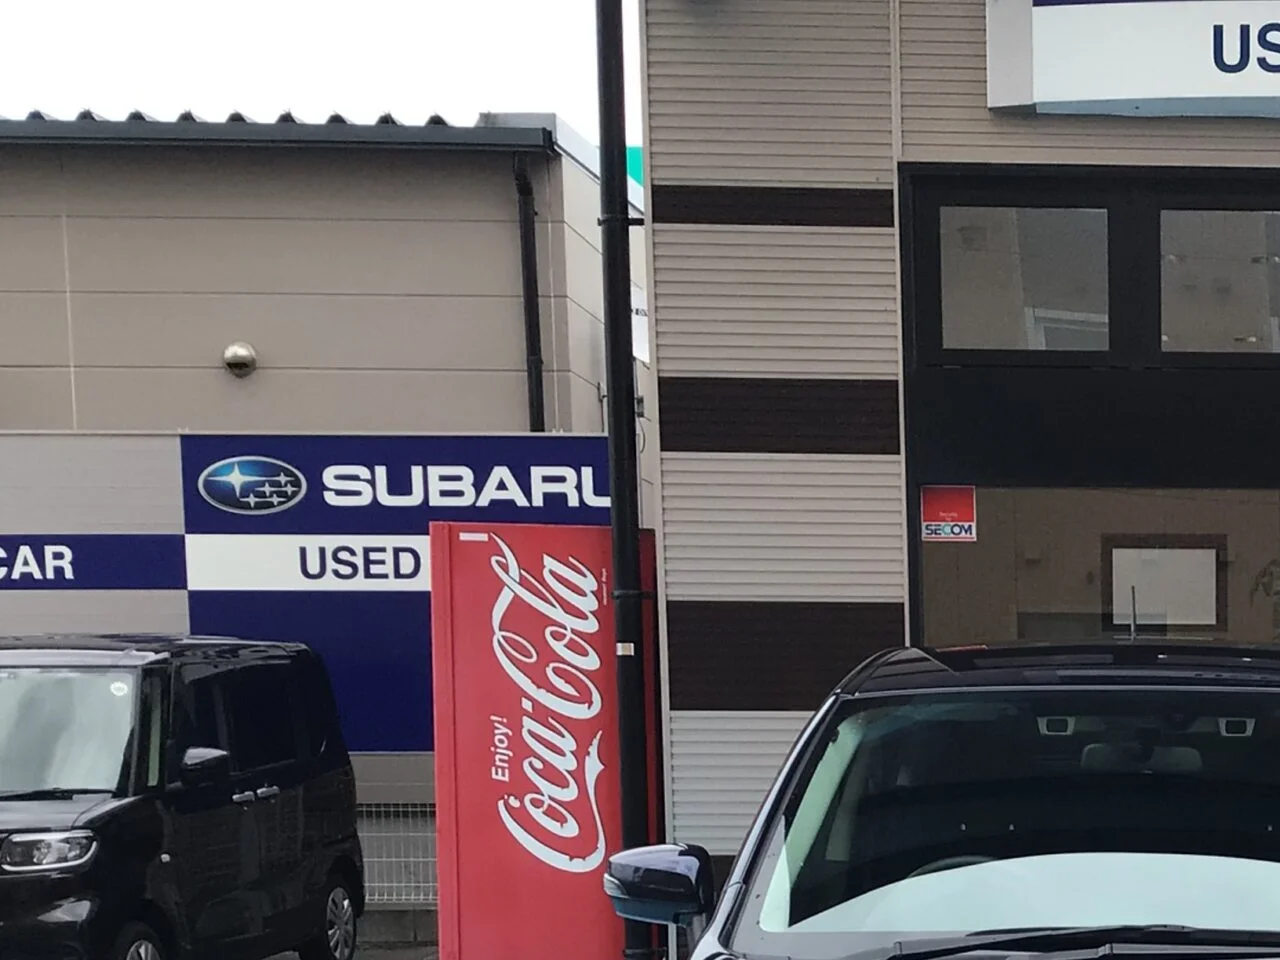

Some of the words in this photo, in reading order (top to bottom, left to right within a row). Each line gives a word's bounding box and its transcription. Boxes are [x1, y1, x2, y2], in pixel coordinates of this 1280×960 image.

[924, 523, 973, 536] SECOM
[0, 544, 75, 580] AR
[299, 545, 421, 580] USED
[490, 715, 513, 782] Enjoy!
